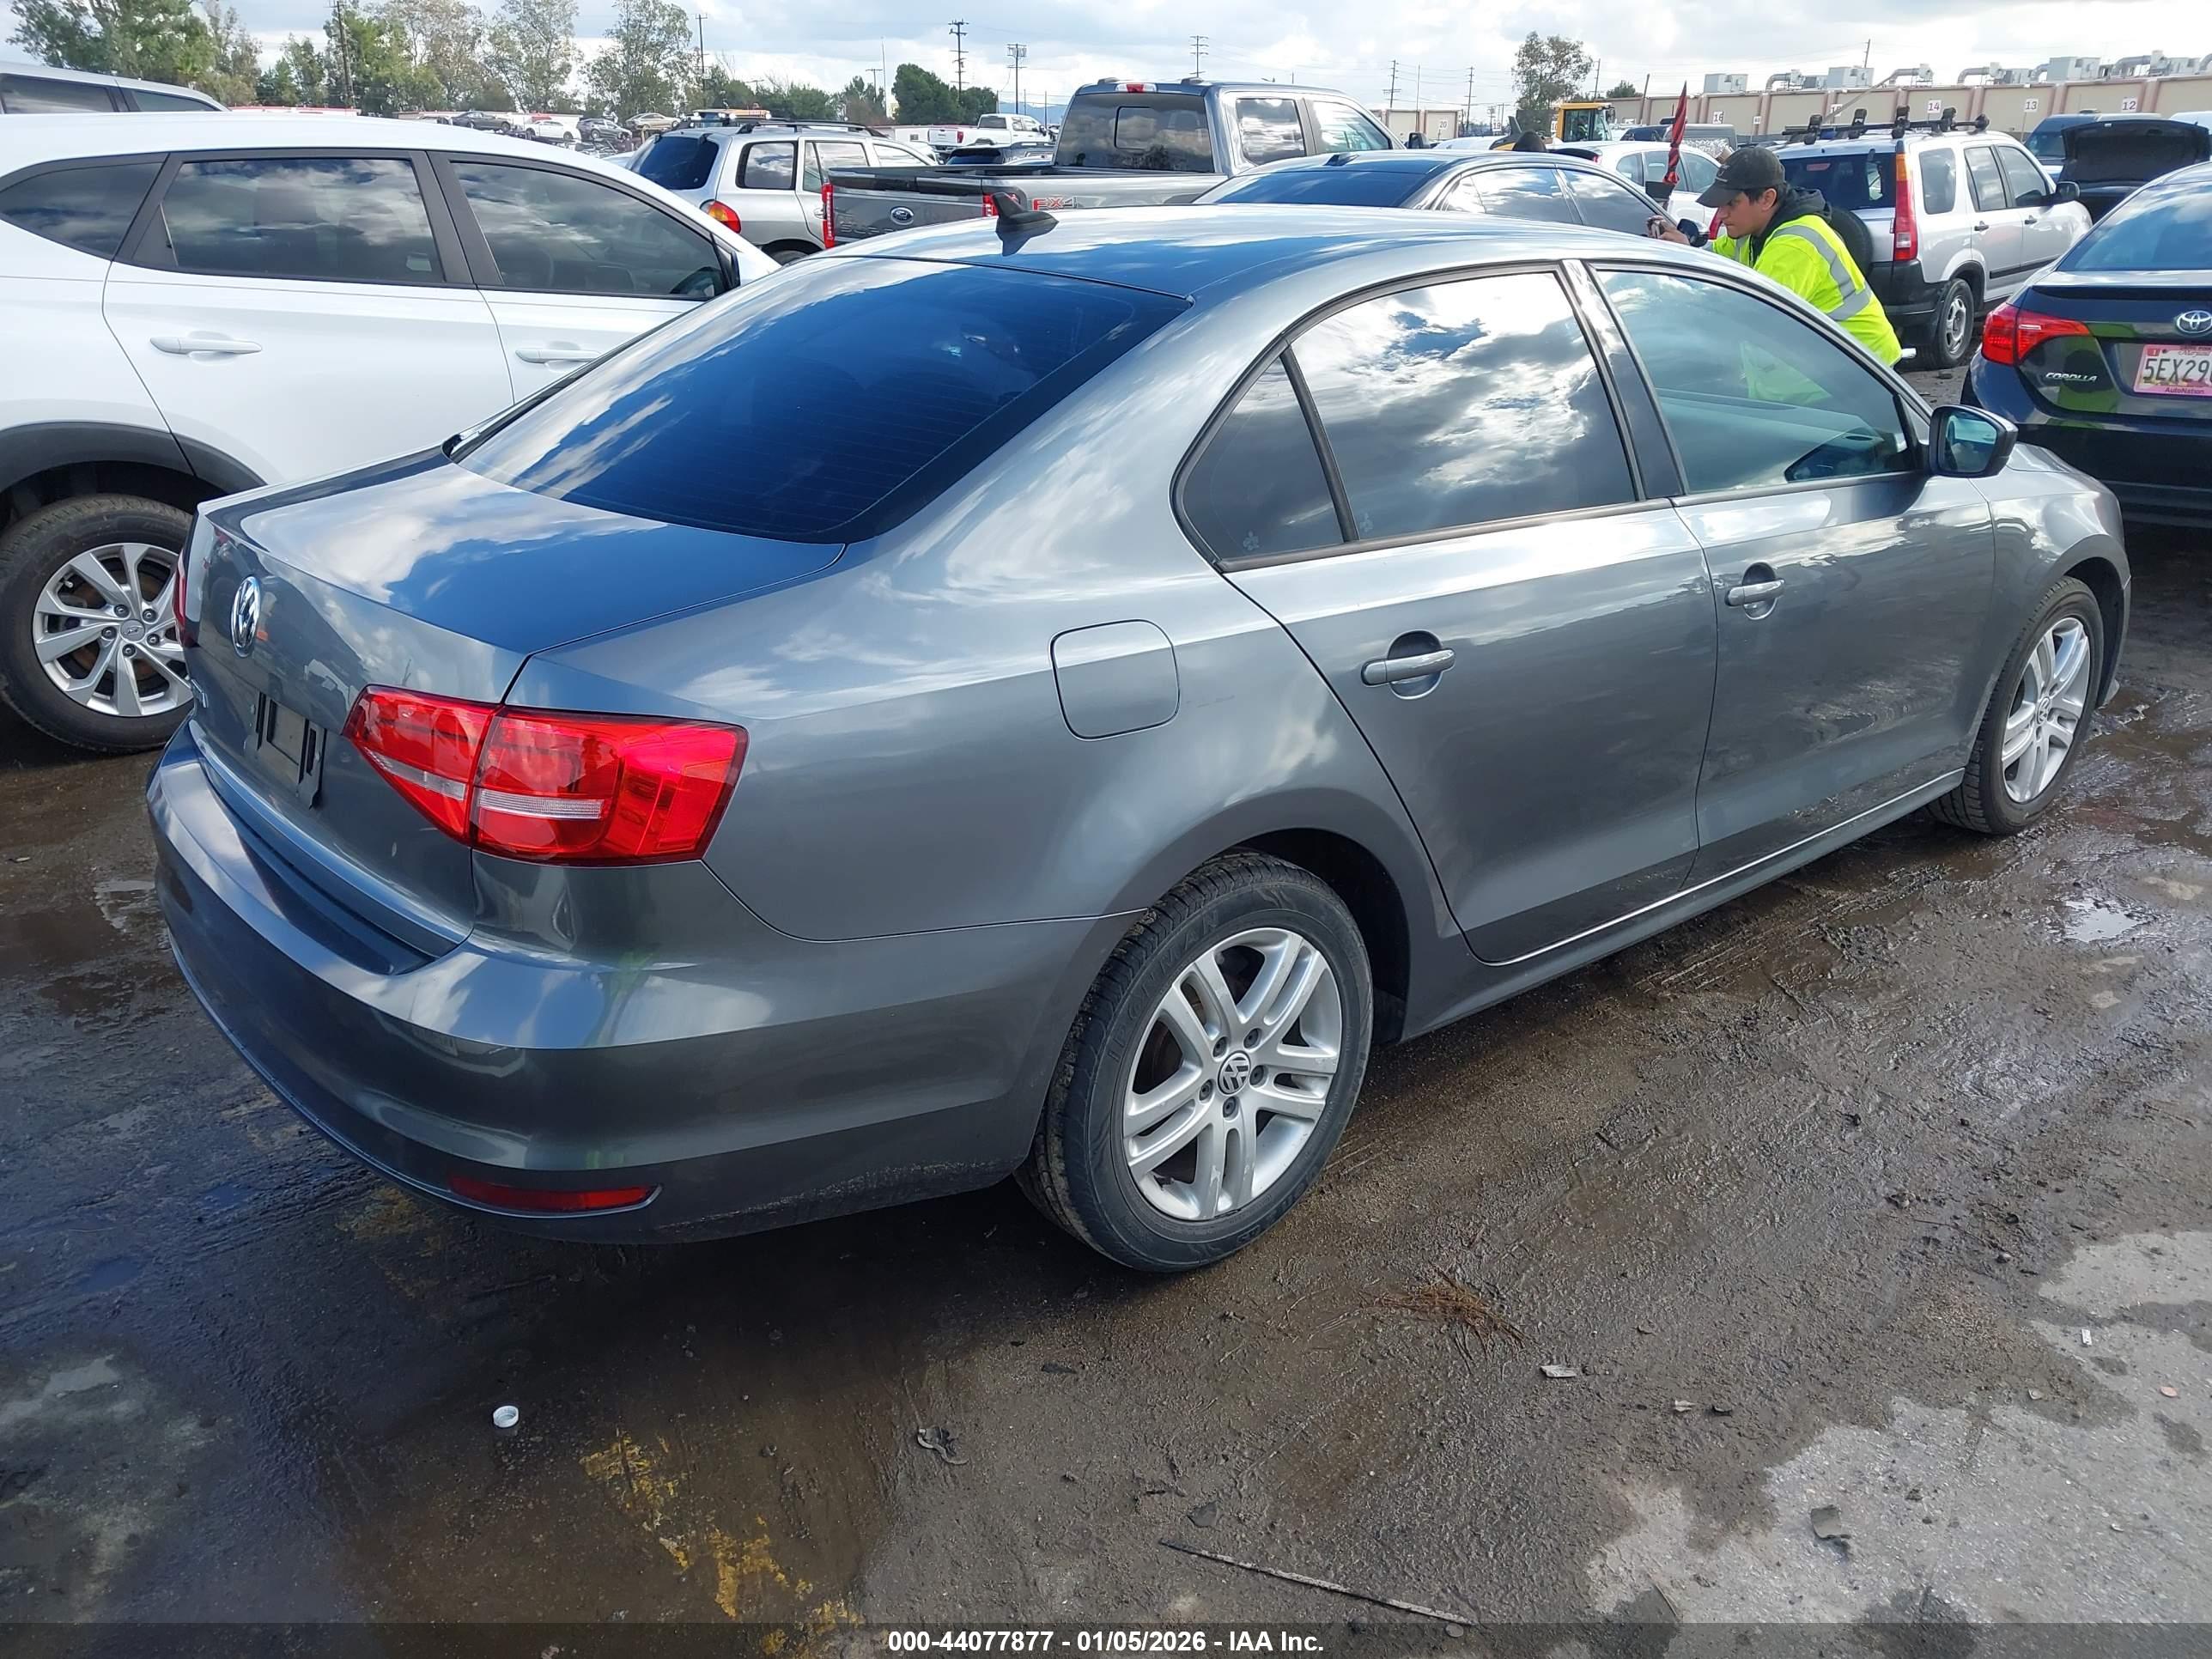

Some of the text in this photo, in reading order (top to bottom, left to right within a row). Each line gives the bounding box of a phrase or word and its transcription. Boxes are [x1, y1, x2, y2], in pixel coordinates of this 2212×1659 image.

[1928, 102, 1940, 112] 14
[2026, 100, 2038, 110] 13
[2122, 100, 2136, 111] 12
[1713, 113, 1724, 123] 16
[1032, 197, 1078, 211] FX4
[2142, 358, 2212, 383] 5EX29
[2045, 372, 2098, 383] COROLLA
